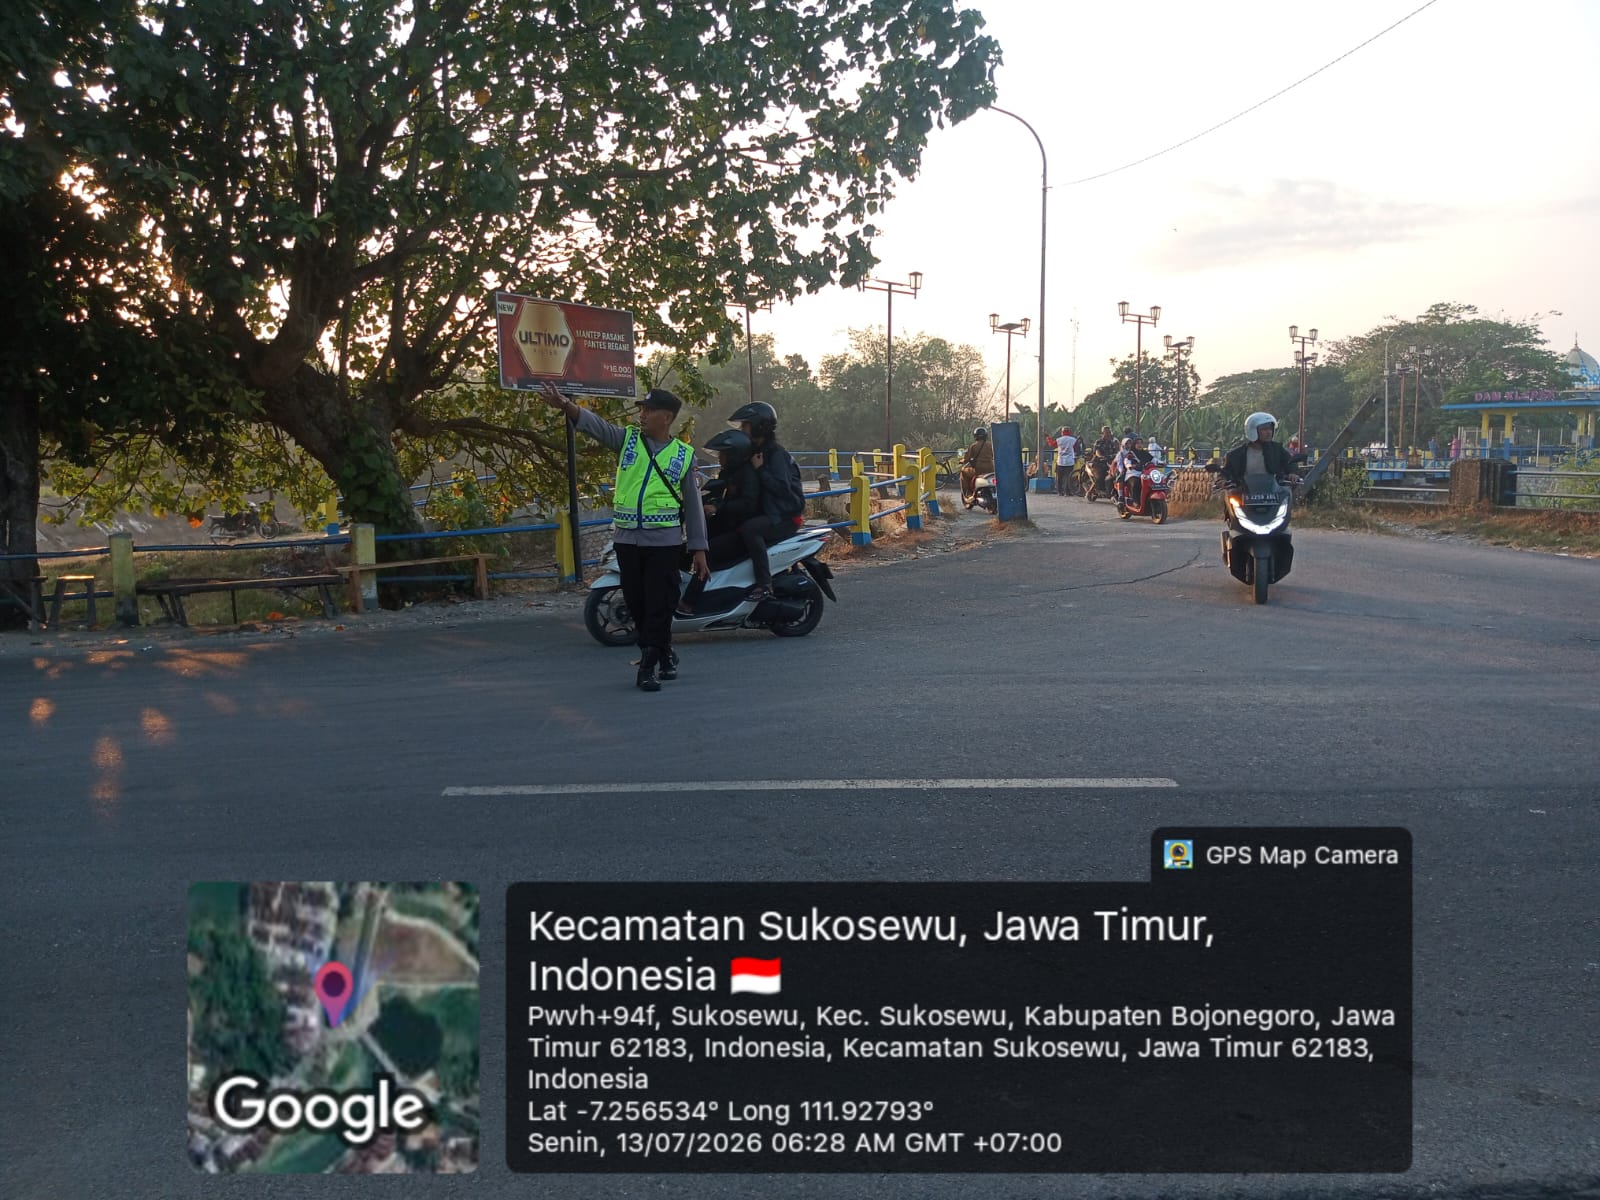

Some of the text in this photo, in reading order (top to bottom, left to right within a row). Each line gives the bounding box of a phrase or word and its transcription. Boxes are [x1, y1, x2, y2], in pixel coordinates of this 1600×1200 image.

[498, 303, 514, 312] NEW
[576, 329, 625, 342] MANTEP RASANE
[584, 340, 630, 351] PANTES REGANE
